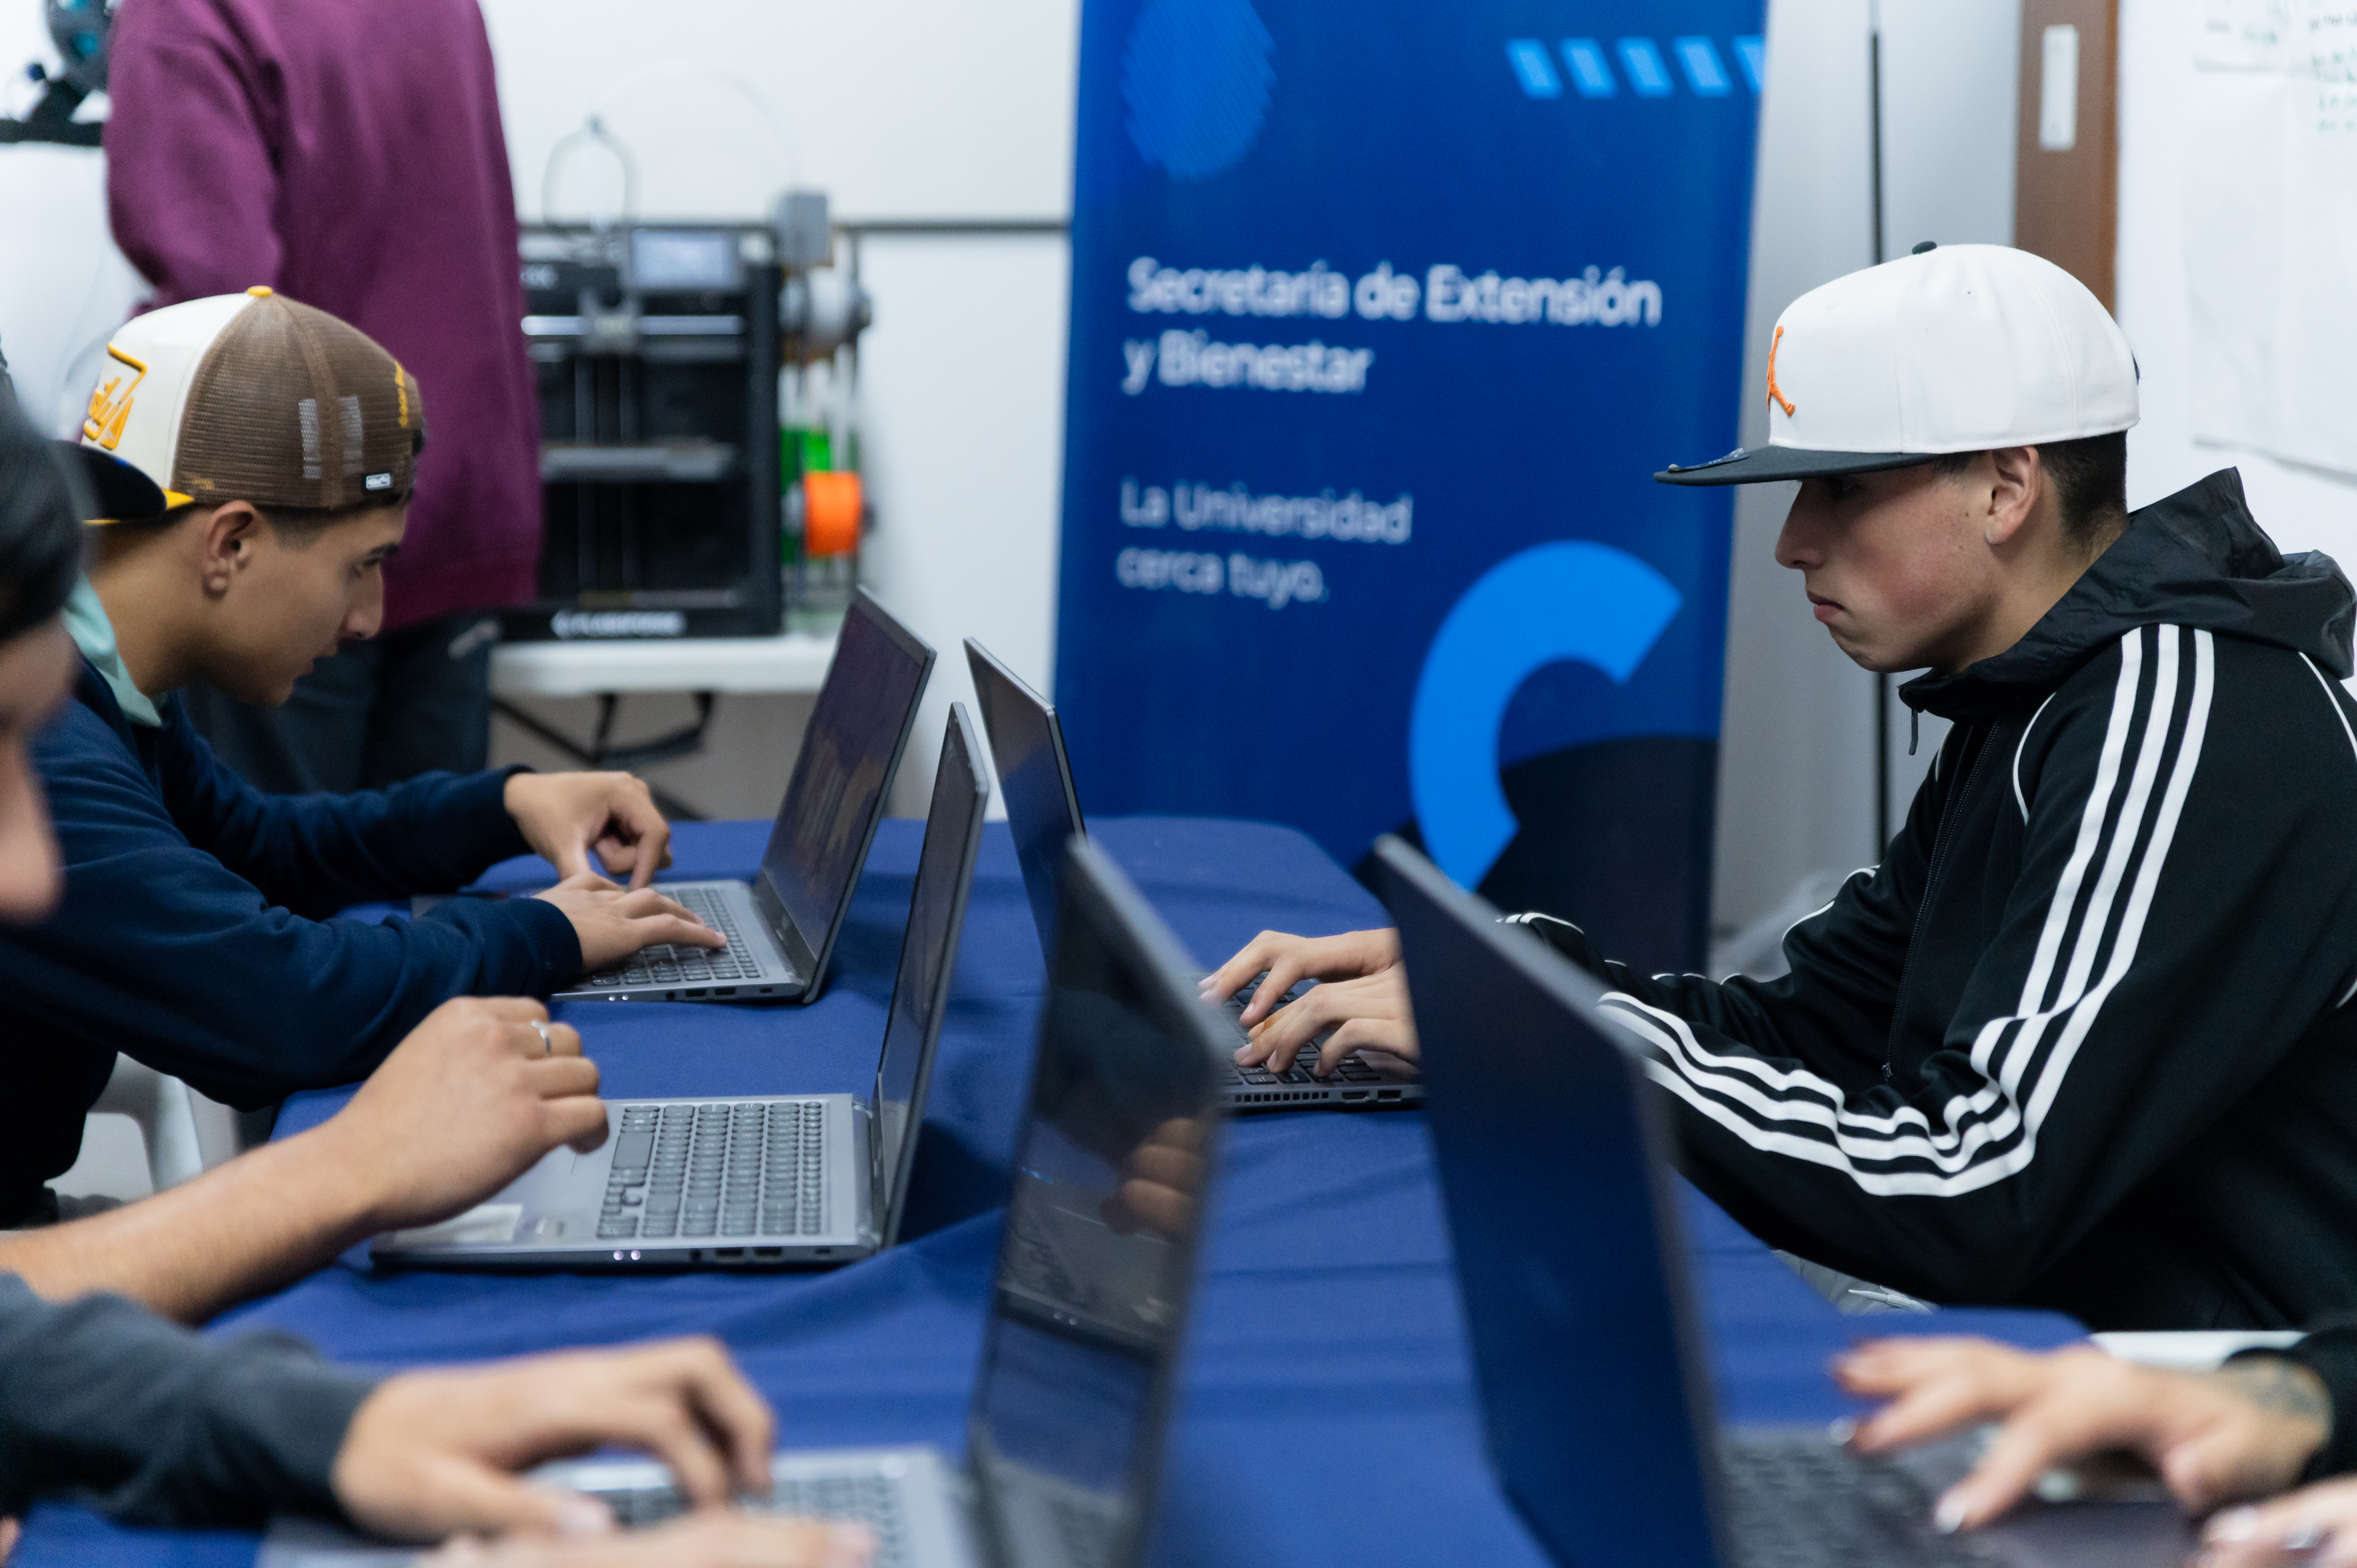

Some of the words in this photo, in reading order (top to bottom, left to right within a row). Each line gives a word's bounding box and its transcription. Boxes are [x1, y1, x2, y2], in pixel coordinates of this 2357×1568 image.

[1128, 256, 1350, 318] Secretaría
[1354, 263, 1420, 320] de
[1425, 265, 1662, 326] Extensión
[1123, 340, 1157, 394] y
[1158, 330, 1373, 392] Bienestar
[1121, 480, 1168, 525] La
[1174, 484, 1412, 543] Universidad
[1118, 548, 1223, 593] cerca
